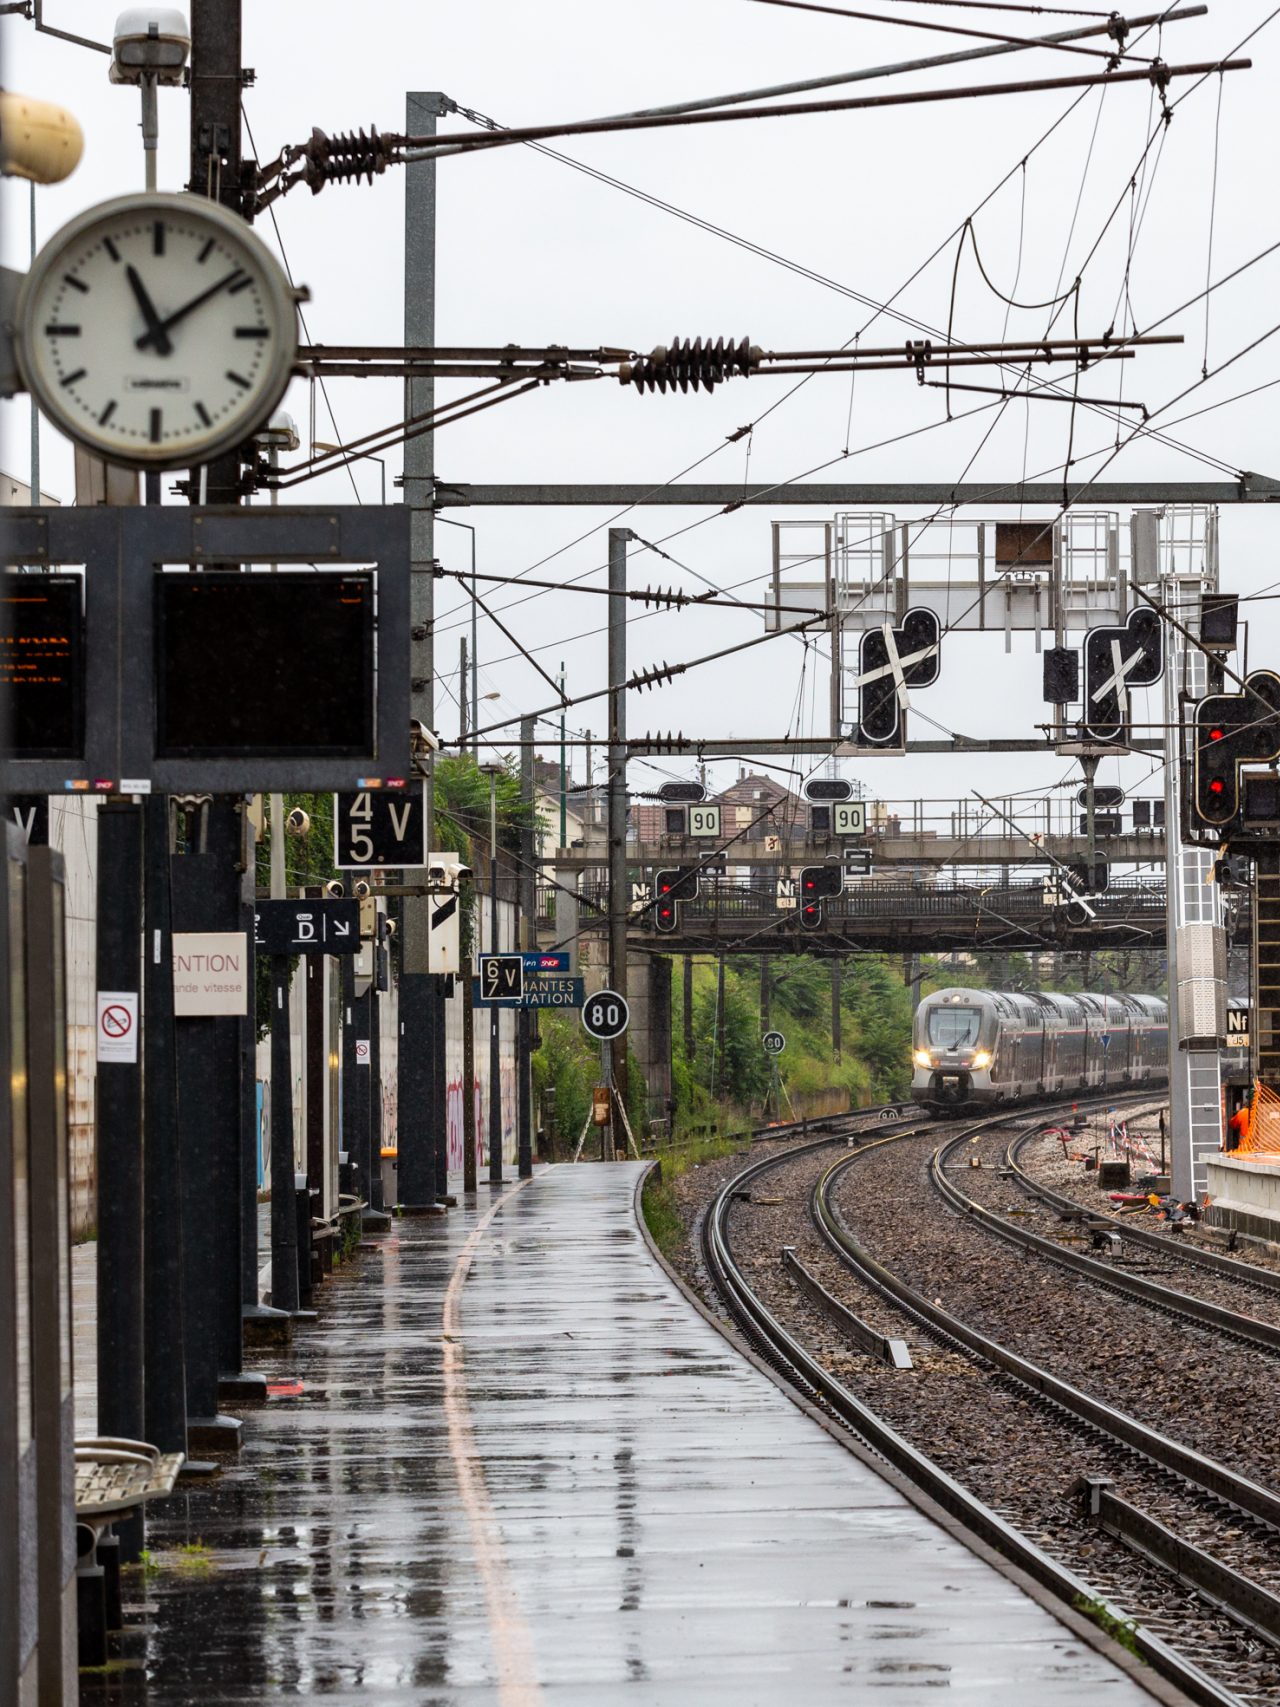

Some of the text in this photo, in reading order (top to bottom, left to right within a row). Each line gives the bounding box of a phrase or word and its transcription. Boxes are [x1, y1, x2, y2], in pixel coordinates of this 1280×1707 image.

[349, 792, 374, 821] 4
[388, 802, 411, 841] V
[694, 812, 716, 830] 90
[839, 810, 861, 827] 90
[298, 922, 314, 939] D
[488, 961, 499, 978] 6
[505, 969, 516, 987] V
[204, 983, 242, 993] vitesse
[488, 979, 499, 996] 7
[592, 1005, 619, 1026] 80
[1228, 1011, 1248, 1031] Nf
[767, 1037, 781, 1048] 80
